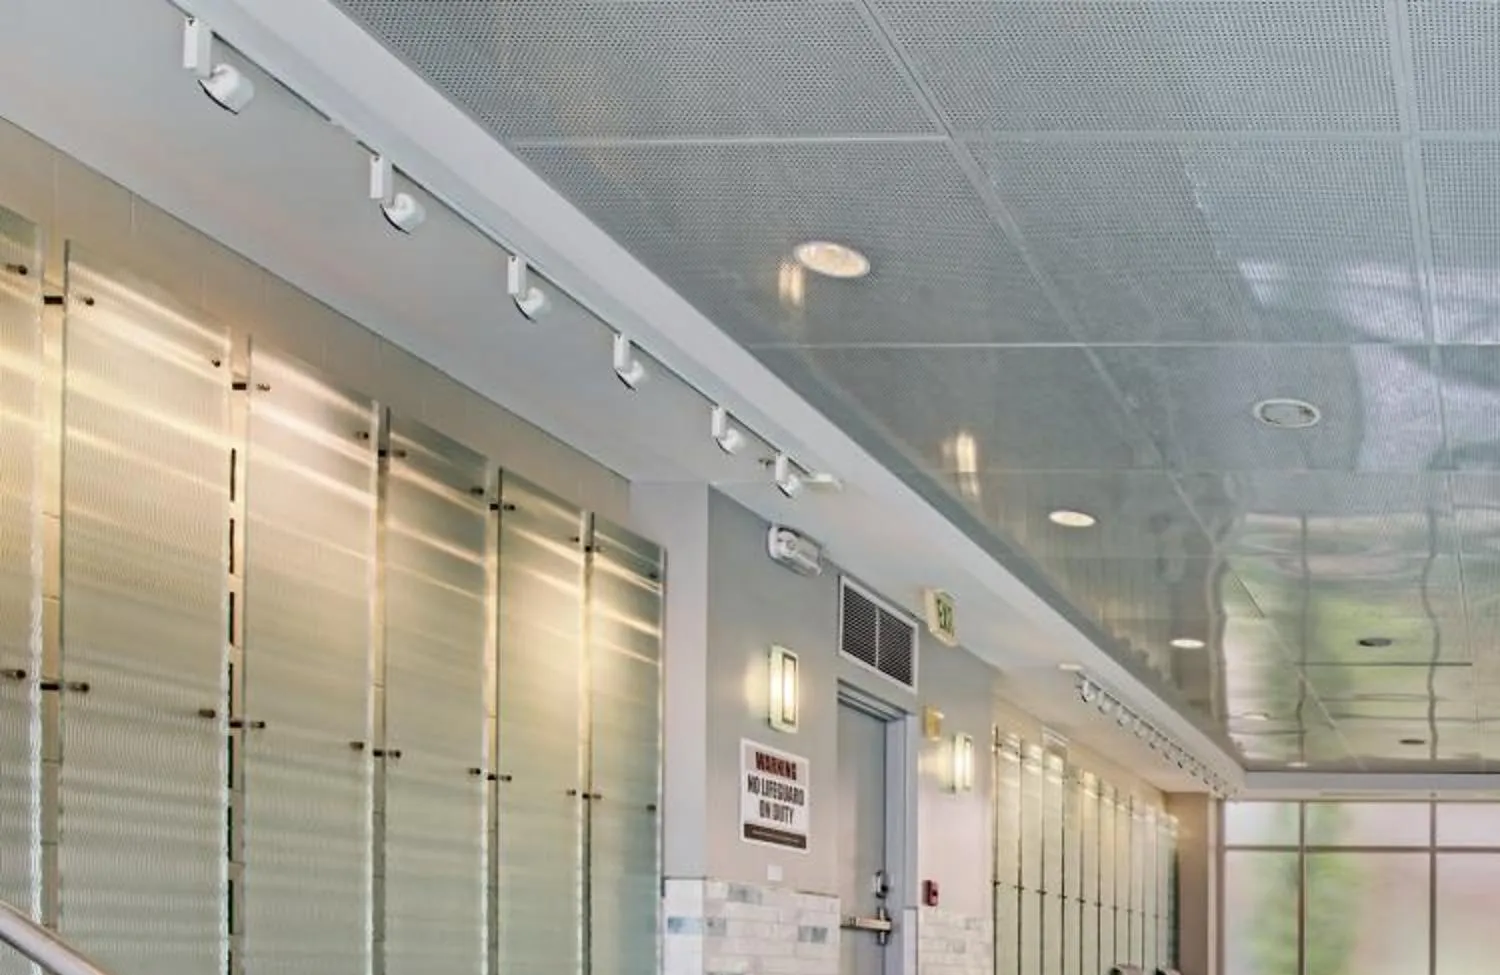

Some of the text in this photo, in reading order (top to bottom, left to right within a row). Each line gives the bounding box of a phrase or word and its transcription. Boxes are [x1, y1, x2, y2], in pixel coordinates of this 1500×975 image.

[755, 751, 797, 781] WARNING
[747, 774, 804, 806] NO LIFEGUARD
[759, 799, 794, 825] ON DUTY
